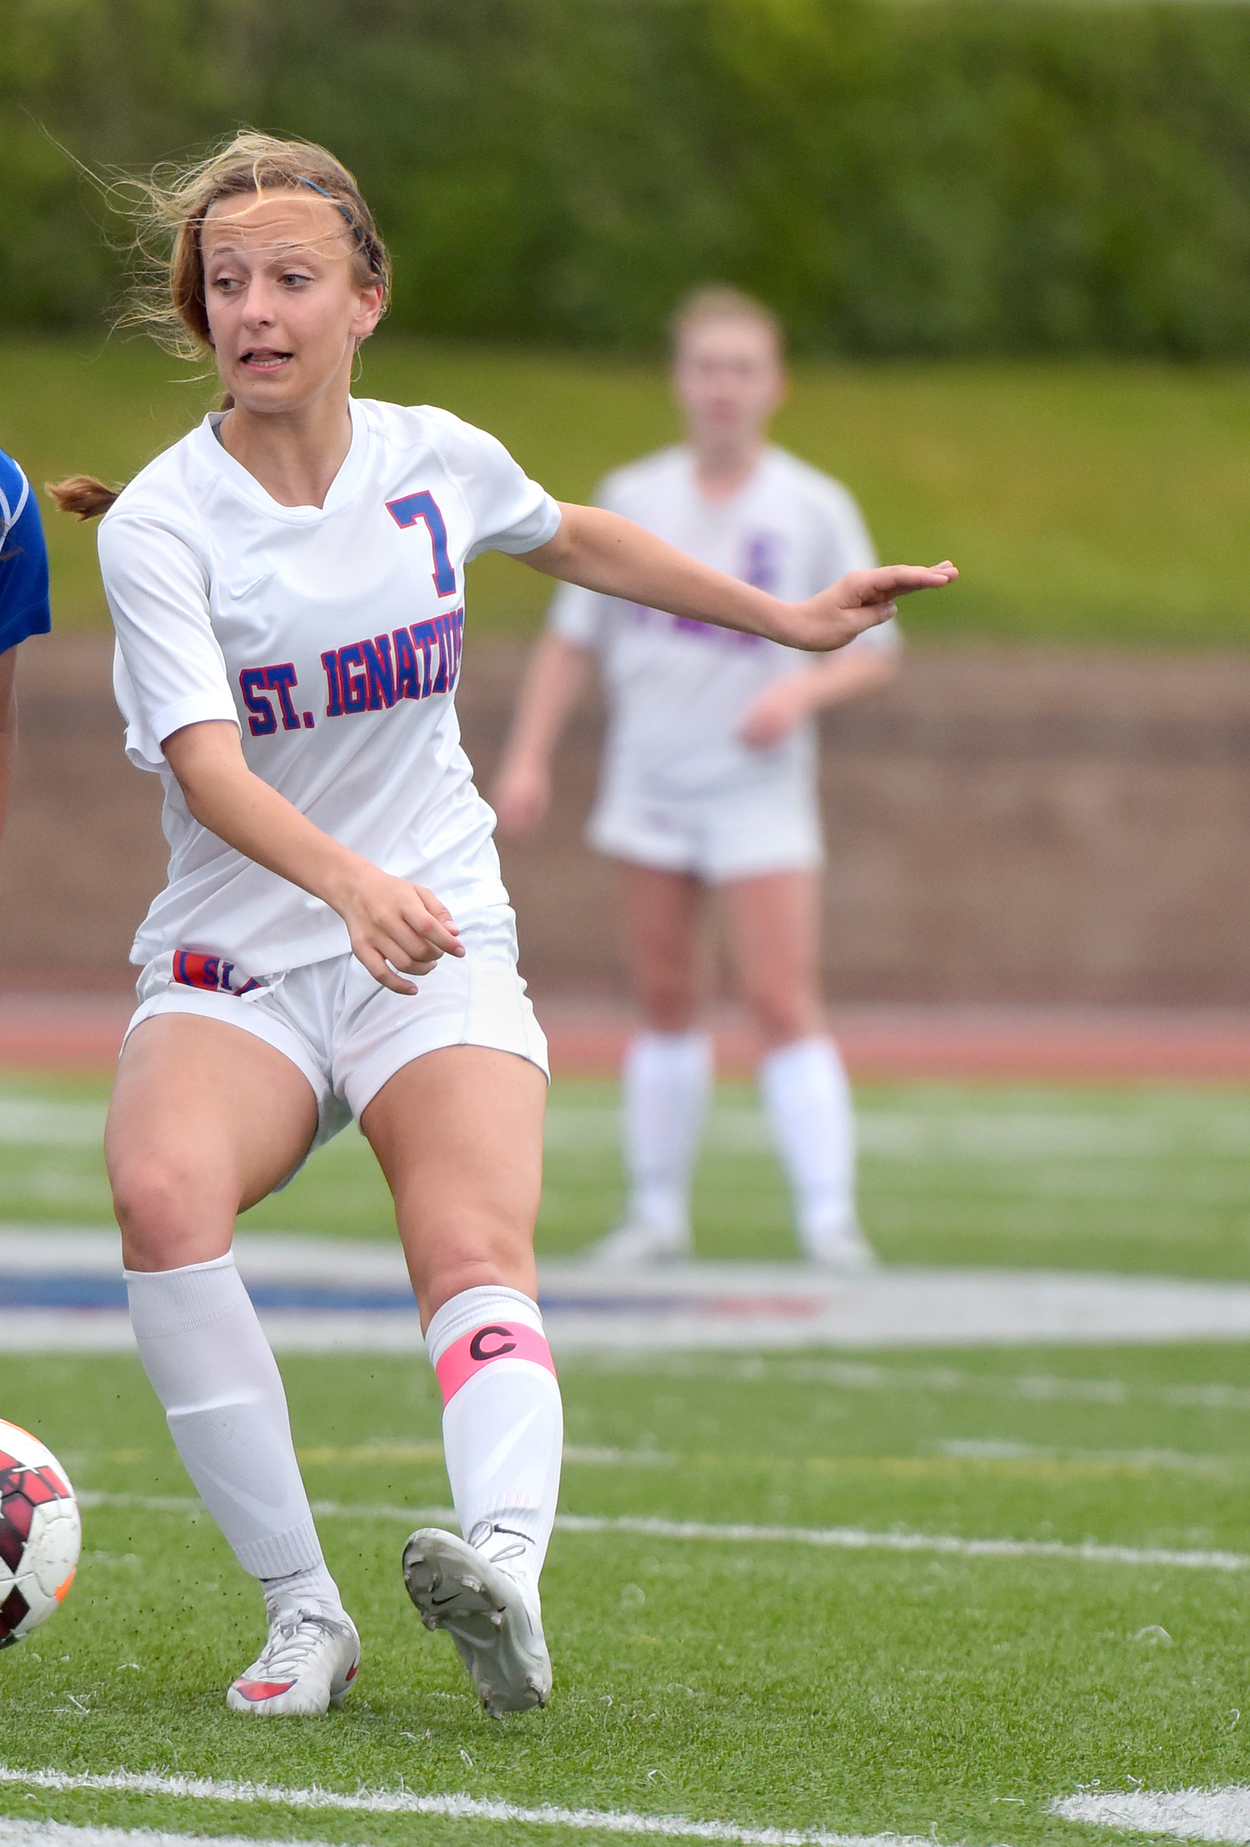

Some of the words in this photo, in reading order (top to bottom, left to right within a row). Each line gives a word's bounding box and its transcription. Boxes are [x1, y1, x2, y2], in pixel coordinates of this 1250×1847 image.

[384, 490, 457, 598] 7
[239, 662, 316, 737] ST.
[469, 1325, 517, 1362] C
